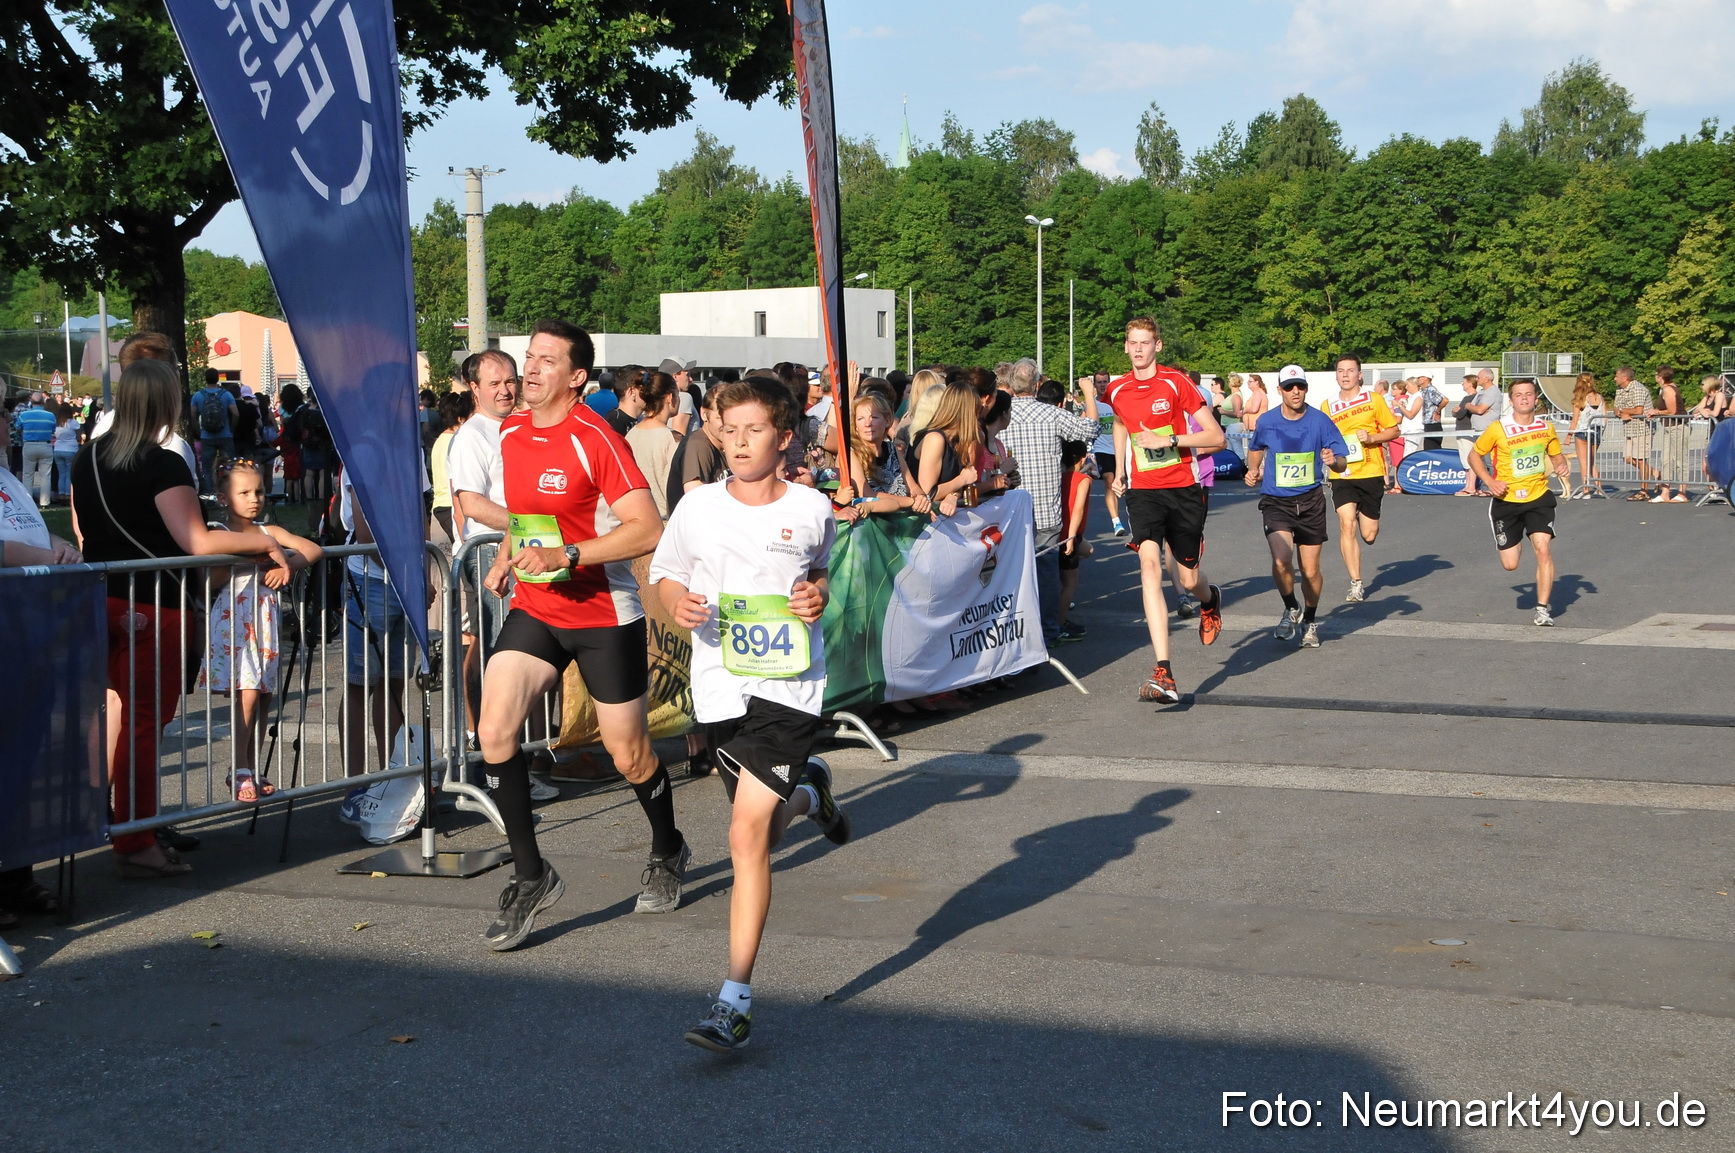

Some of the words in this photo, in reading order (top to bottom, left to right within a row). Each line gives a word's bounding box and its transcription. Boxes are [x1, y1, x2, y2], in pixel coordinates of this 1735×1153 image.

[1507, 436, 1528, 446] MAX
[1531, 432, 1551, 440] BÖGL
[1516, 455, 1540, 470] 829
[1281, 464, 1307, 478] 721
[1418, 468, 1467, 480] Fische
[766, 545, 802, 557] Lammsbräu
[730, 623, 794, 657] 894
